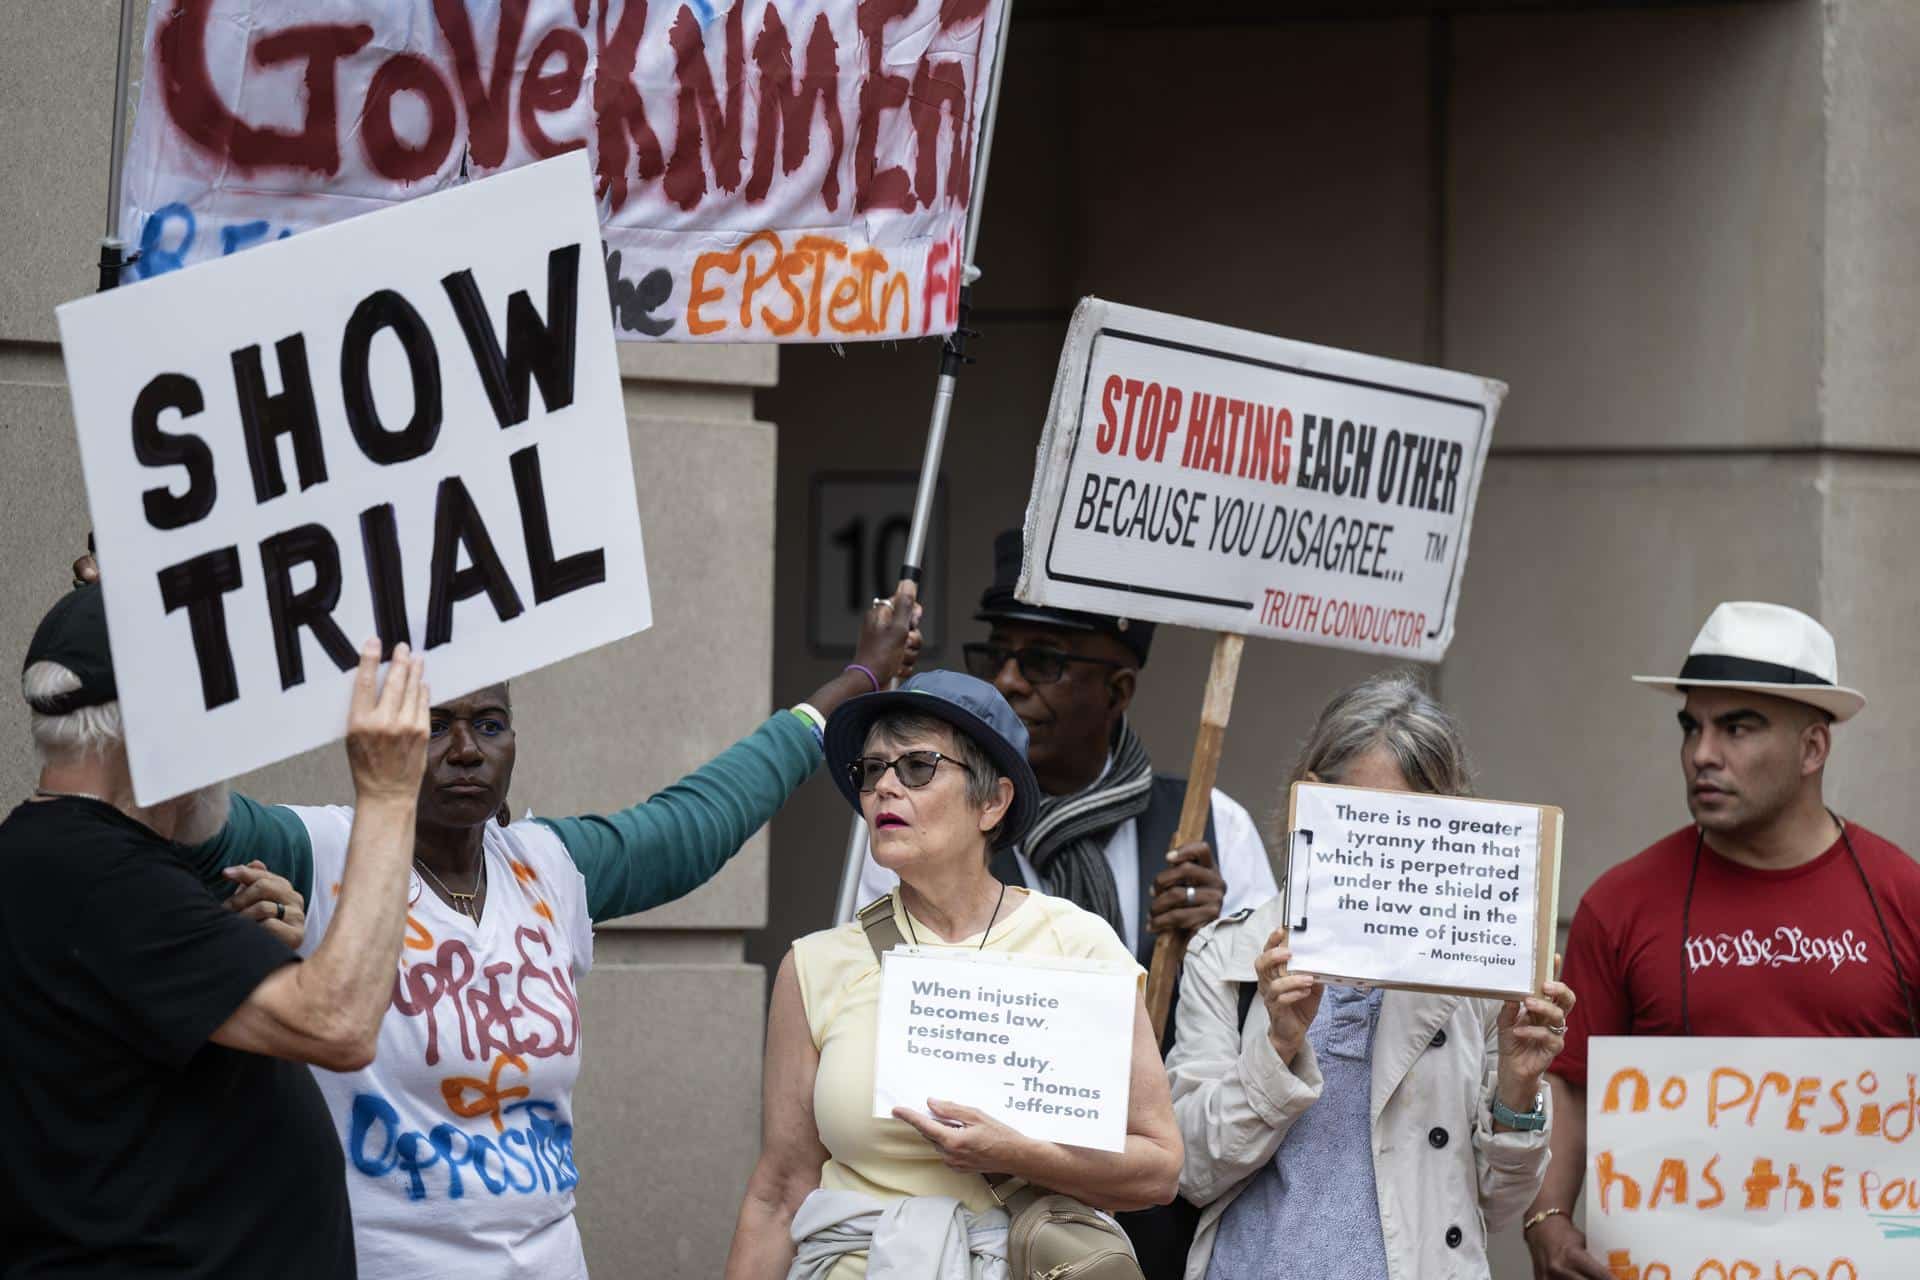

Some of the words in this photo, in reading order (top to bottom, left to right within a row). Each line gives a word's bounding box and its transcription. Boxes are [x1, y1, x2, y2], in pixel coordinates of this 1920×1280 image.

[601, 239, 676, 337] he
[131, 243, 581, 531] SHOW
[1096, 375, 1182, 462] STOP
[1182, 392, 1292, 484] HATING
[1298, 413, 1377, 499] EACH
[1377, 429, 1462, 515] OTHER
[1075, 473, 1206, 548] BECAUSE
[1208, 495, 1264, 556] YOU
[1261, 506, 1403, 582] DISAGREE...
[832, 514, 911, 612] 10
[1424, 532, 1447, 563] TM
[157, 443, 605, 711] TRIAL
[1260, 589, 1319, 633] TRUTH
[1322, 600, 1425, 648] CONDUCTOR
[1336, 805, 1390, 825] There
[1397, 810, 1410, 826] is
[1418, 815, 1441, 829] no
[1449, 820, 1522, 837] greater
[1348, 830, 1425, 855] tyranny
[1432, 837, 1475, 855] than
[1482, 841, 1520, 858] that
[1317, 849, 1373, 867] which
[1381, 854, 1395, 869] is
[1401, 858, 1519, 880] perpetrated
[1333, 874, 1391, 891] under
[1399, 877, 1428, 894] the
[1435, 883, 1492, 900] shield
[1499, 887, 1519, 902] of
[1338, 895, 1369, 911] the
[1376, 897, 1412, 914] law
[1419, 903, 1456, 919] and
[1464, 903, 1480, 921] in
[1487, 907, 1517, 924] the
[1364, 921, 1418, 938] name
[1426, 924, 1446, 941] of
[1452, 926, 1517, 947] justice.
[1431, 949, 1516, 966] Montesquieu
[1685, 933, 1734, 974] We
[1732, 929, 1774, 966] the
[1772, 926, 1868, 974] People
[912, 980, 970, 1000] When
[978, 986, 1059, 1008] injustice
[910, 1001, 999, 1023] becomes
[908, 1024, 1010, 1045] resistance
[907, 1040, 996, 1065] becomes
[1003, 1051, 1055, 1073] duty.
[1022, 1077, 1101, 1100] Thomas
[1004, 1096, 1099, 1120] Jefferson
